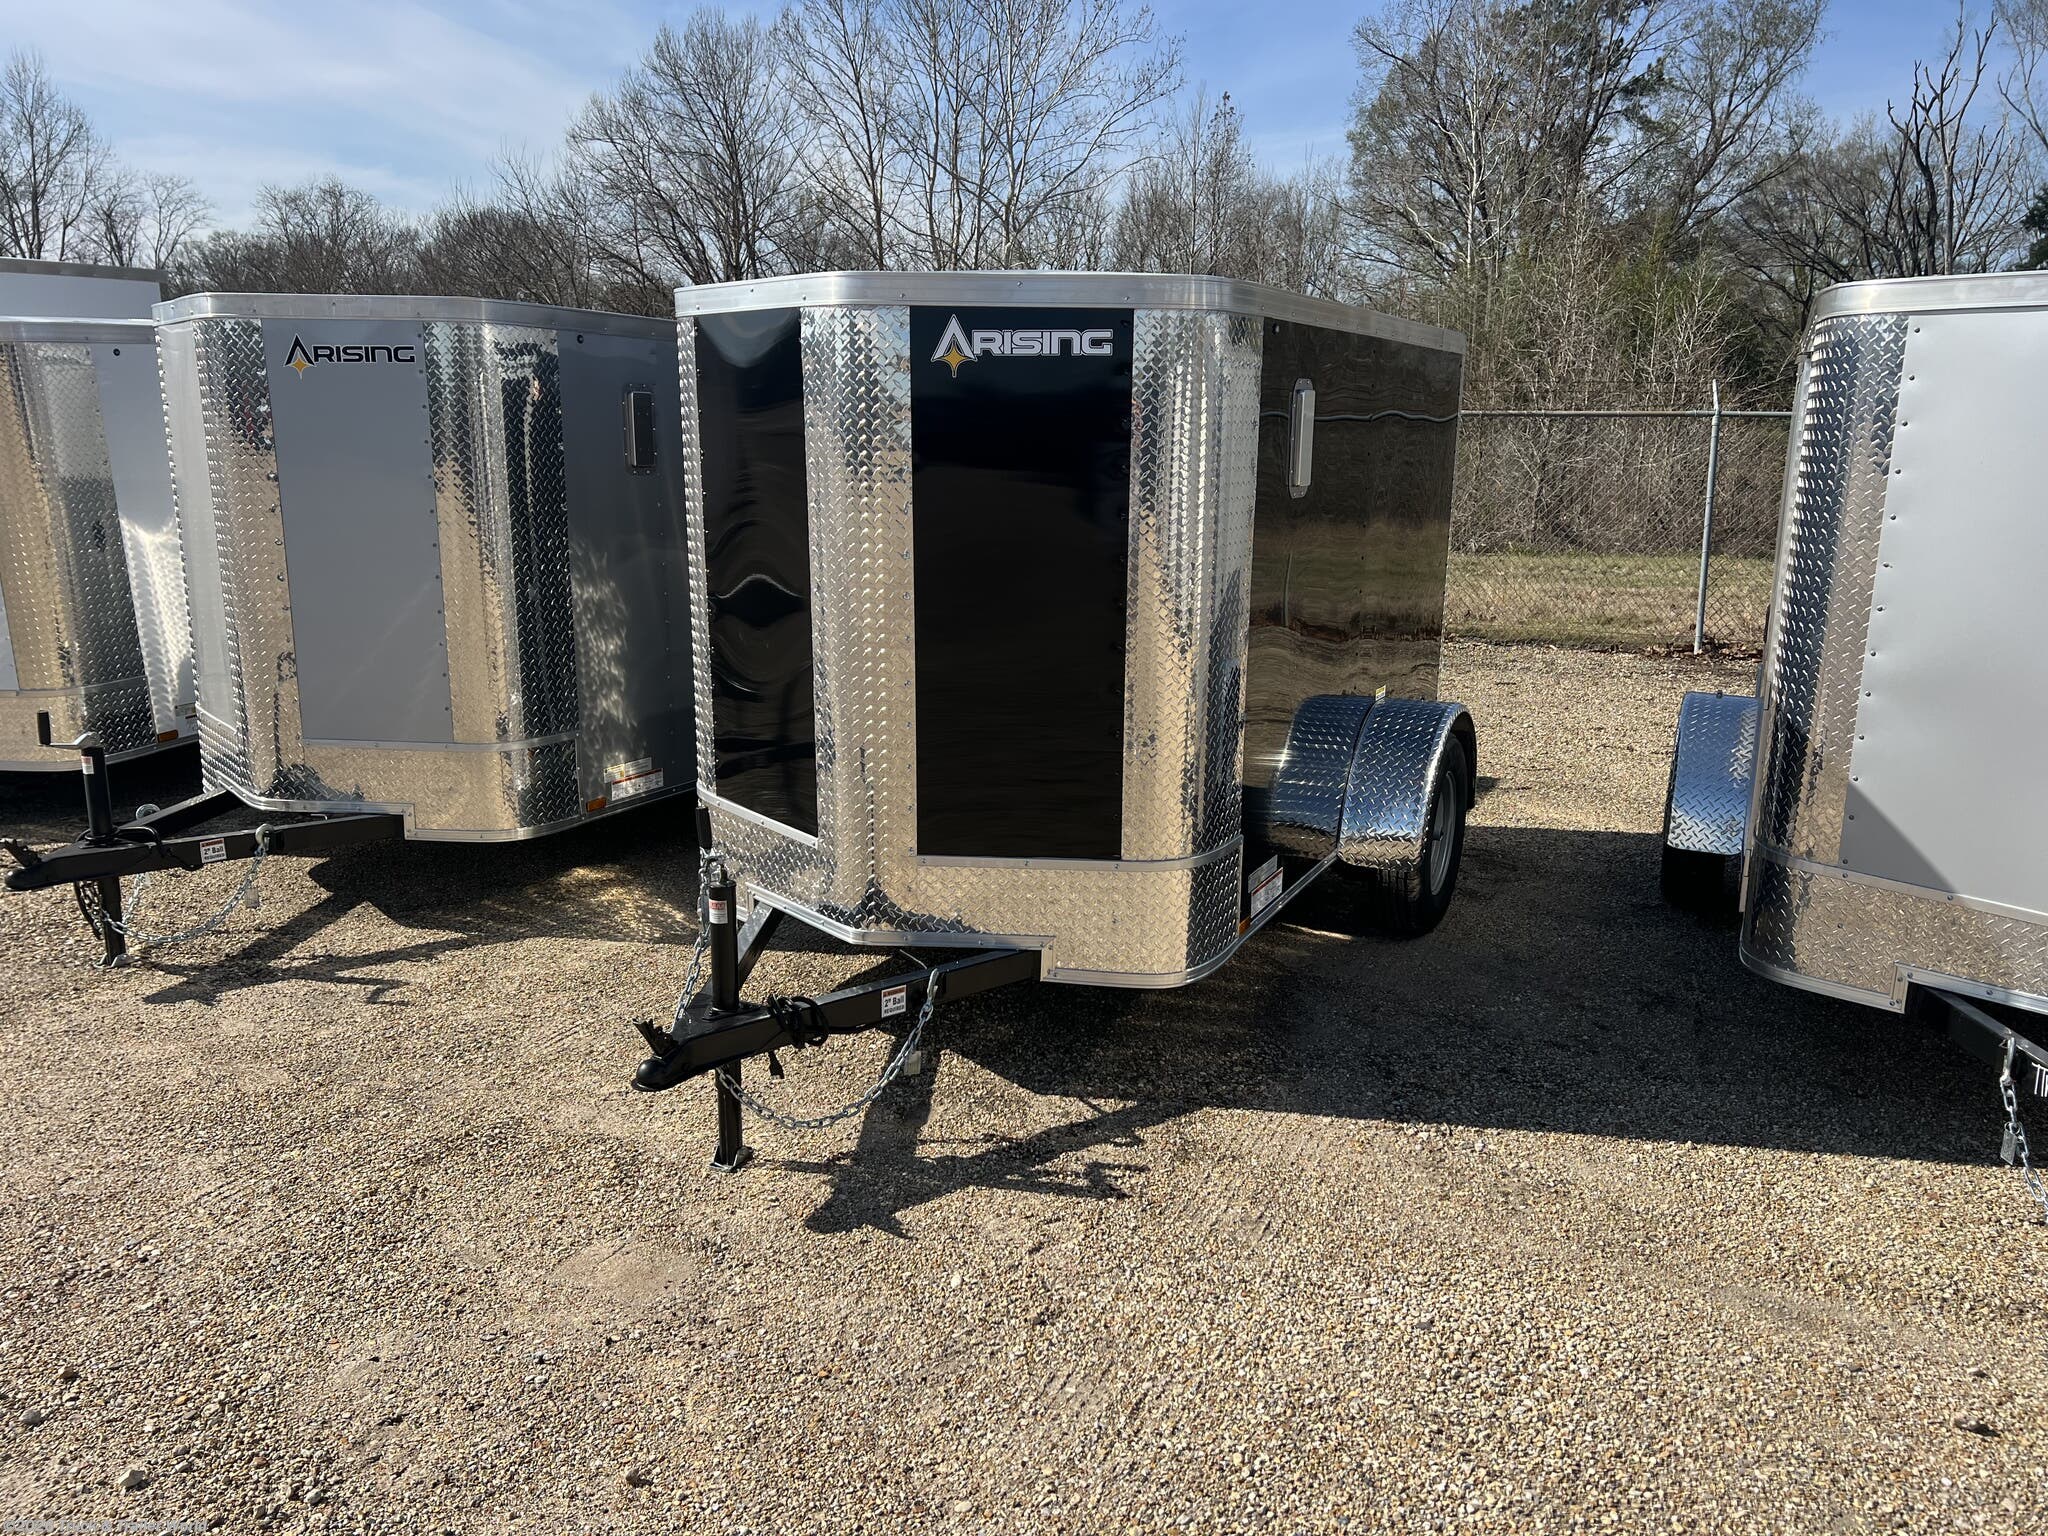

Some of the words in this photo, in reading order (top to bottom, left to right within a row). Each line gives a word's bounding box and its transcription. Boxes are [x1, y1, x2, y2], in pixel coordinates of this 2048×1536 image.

[283, 333, 416, 368] ARISING
[931, 314, 1114, 363] ARISING
[892, 995, 905, 1006] Ball
